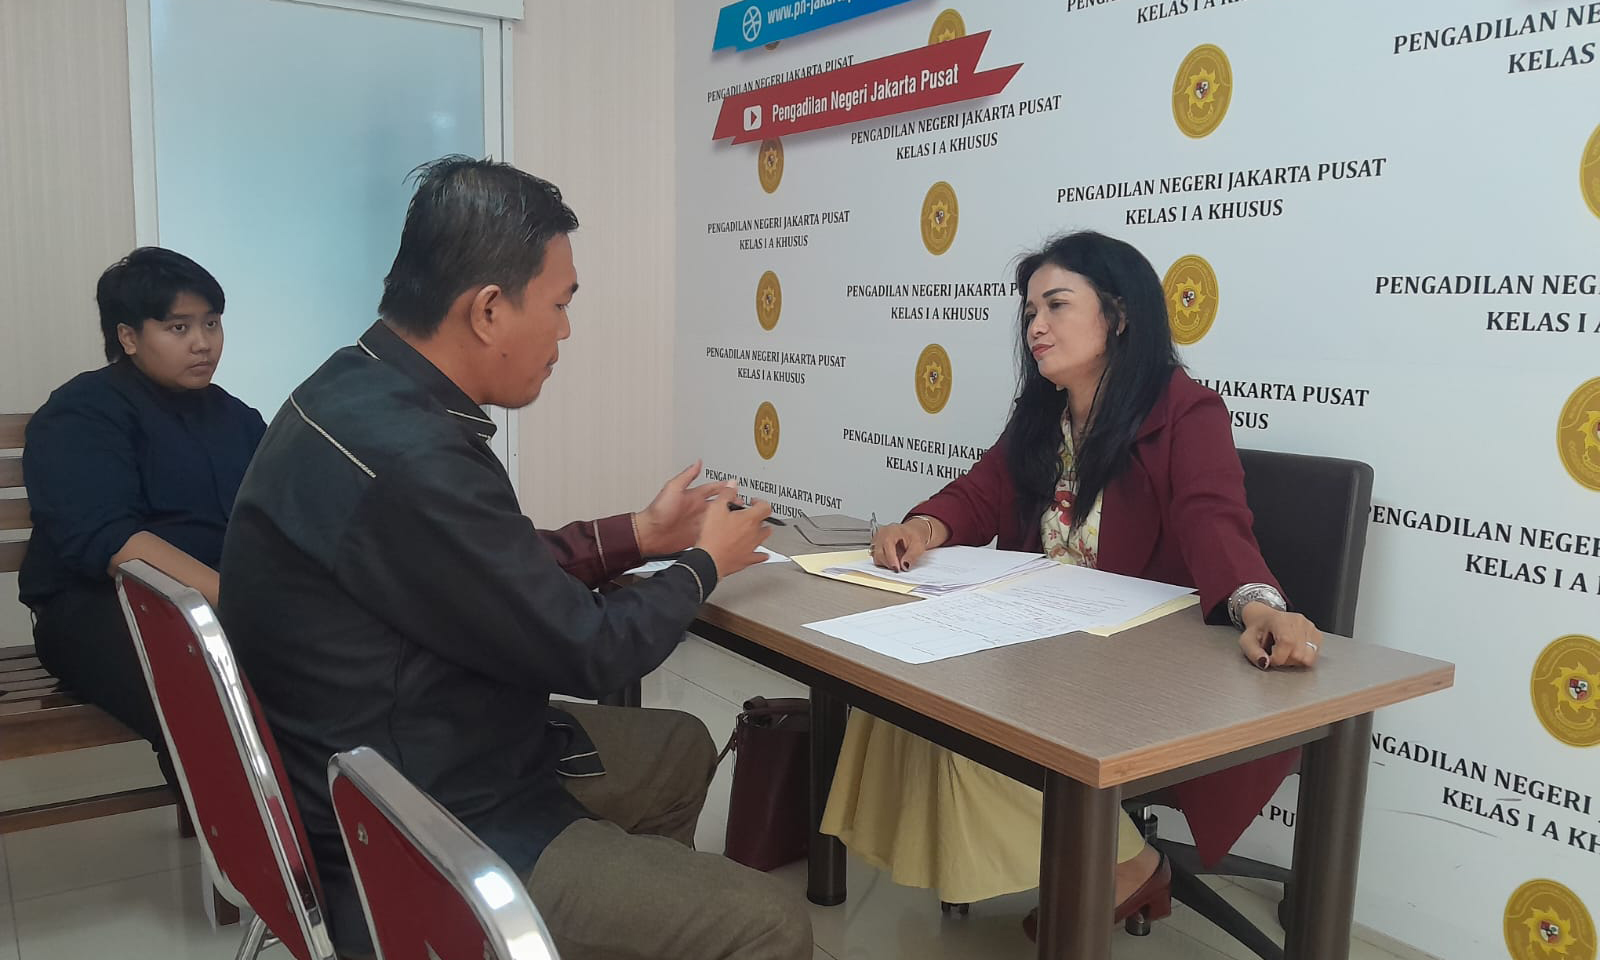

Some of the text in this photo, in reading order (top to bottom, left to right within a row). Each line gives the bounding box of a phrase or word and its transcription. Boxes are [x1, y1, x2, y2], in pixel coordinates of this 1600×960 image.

[1137, 0, 1188, 24] KELAS
[1394, 10, 1557, 54] PENGADILAN
[826, 54, 854, 73] PUSAT
[1508, 42, 1596, 74] KELAS
[772, 64, 959, 123] Pengadilan Negeri Jakarta Pusat
[851, 94, 1062, 144] PENGADILAN NEGERI JAKARTA PUSAT
[896, 132, 998, 160] KELAS I A KHUSUS
[1056, 158, 1387, 204] PENGADILAN NEGERI JAKARTA PUSAT
[708, 210, 850, 234] PENGADILAN NEGERI JAKARTA PUSAT
[1125, 199, 1284, 225] KELAS I A KHUSUS
[740, 238, 762, 250] KELAS
[768, 238, 774, 248] A
[776, 234, 808, 248] KHUSUS
[846, 284, 908, 297] PENGADILAN
[912, 284, 951, 297] NEGERI
[954, 282, 1006, 300] JAKARTA
[1375, 275, 1534, 294] PENGADILAN
[891, 307, 990, 320] KELAS I A KHUSUS
[1486, 311, 1570, 332] KELAS
[1577, 312, 1587, 332] I
[706, 346, 846, 368] PENGADILAN NEGERI JAKARTA PUSAT
[738, 368, 760, 380] KELAS
[766, 370, 772, 381] A
[774, 370, 805, 384] KHUSUS
[1302, 386, 1370, 406] PUSAT
[843, 428, 986, 460] PENGADILAN NEGERI JAKAR
[886, 456, 918, 472] KELAS
[920, 462, 924, 474] I
[926, 464, 934, 476] A
[750, 479, 777, 494] NEGERI
[778, 485, 813, 503] JAKARTA
[815, 494, 842, 510] PUSAT
[771, 502, 803, 518] KHUSUS
[1369, 505, 1512, 544] ENGADILAN
[1465, 554, 1547, 585] KELAS
[1553, 568, 1563, 588] I
[1569, 572, 1588, 593] A
[1494, 768, 1592, 815] NEGERI
[1442, 787, 1520, 828] KELAS
[1526, 814, 1536, 832] I
[1541, 820, 1560, 841] A
